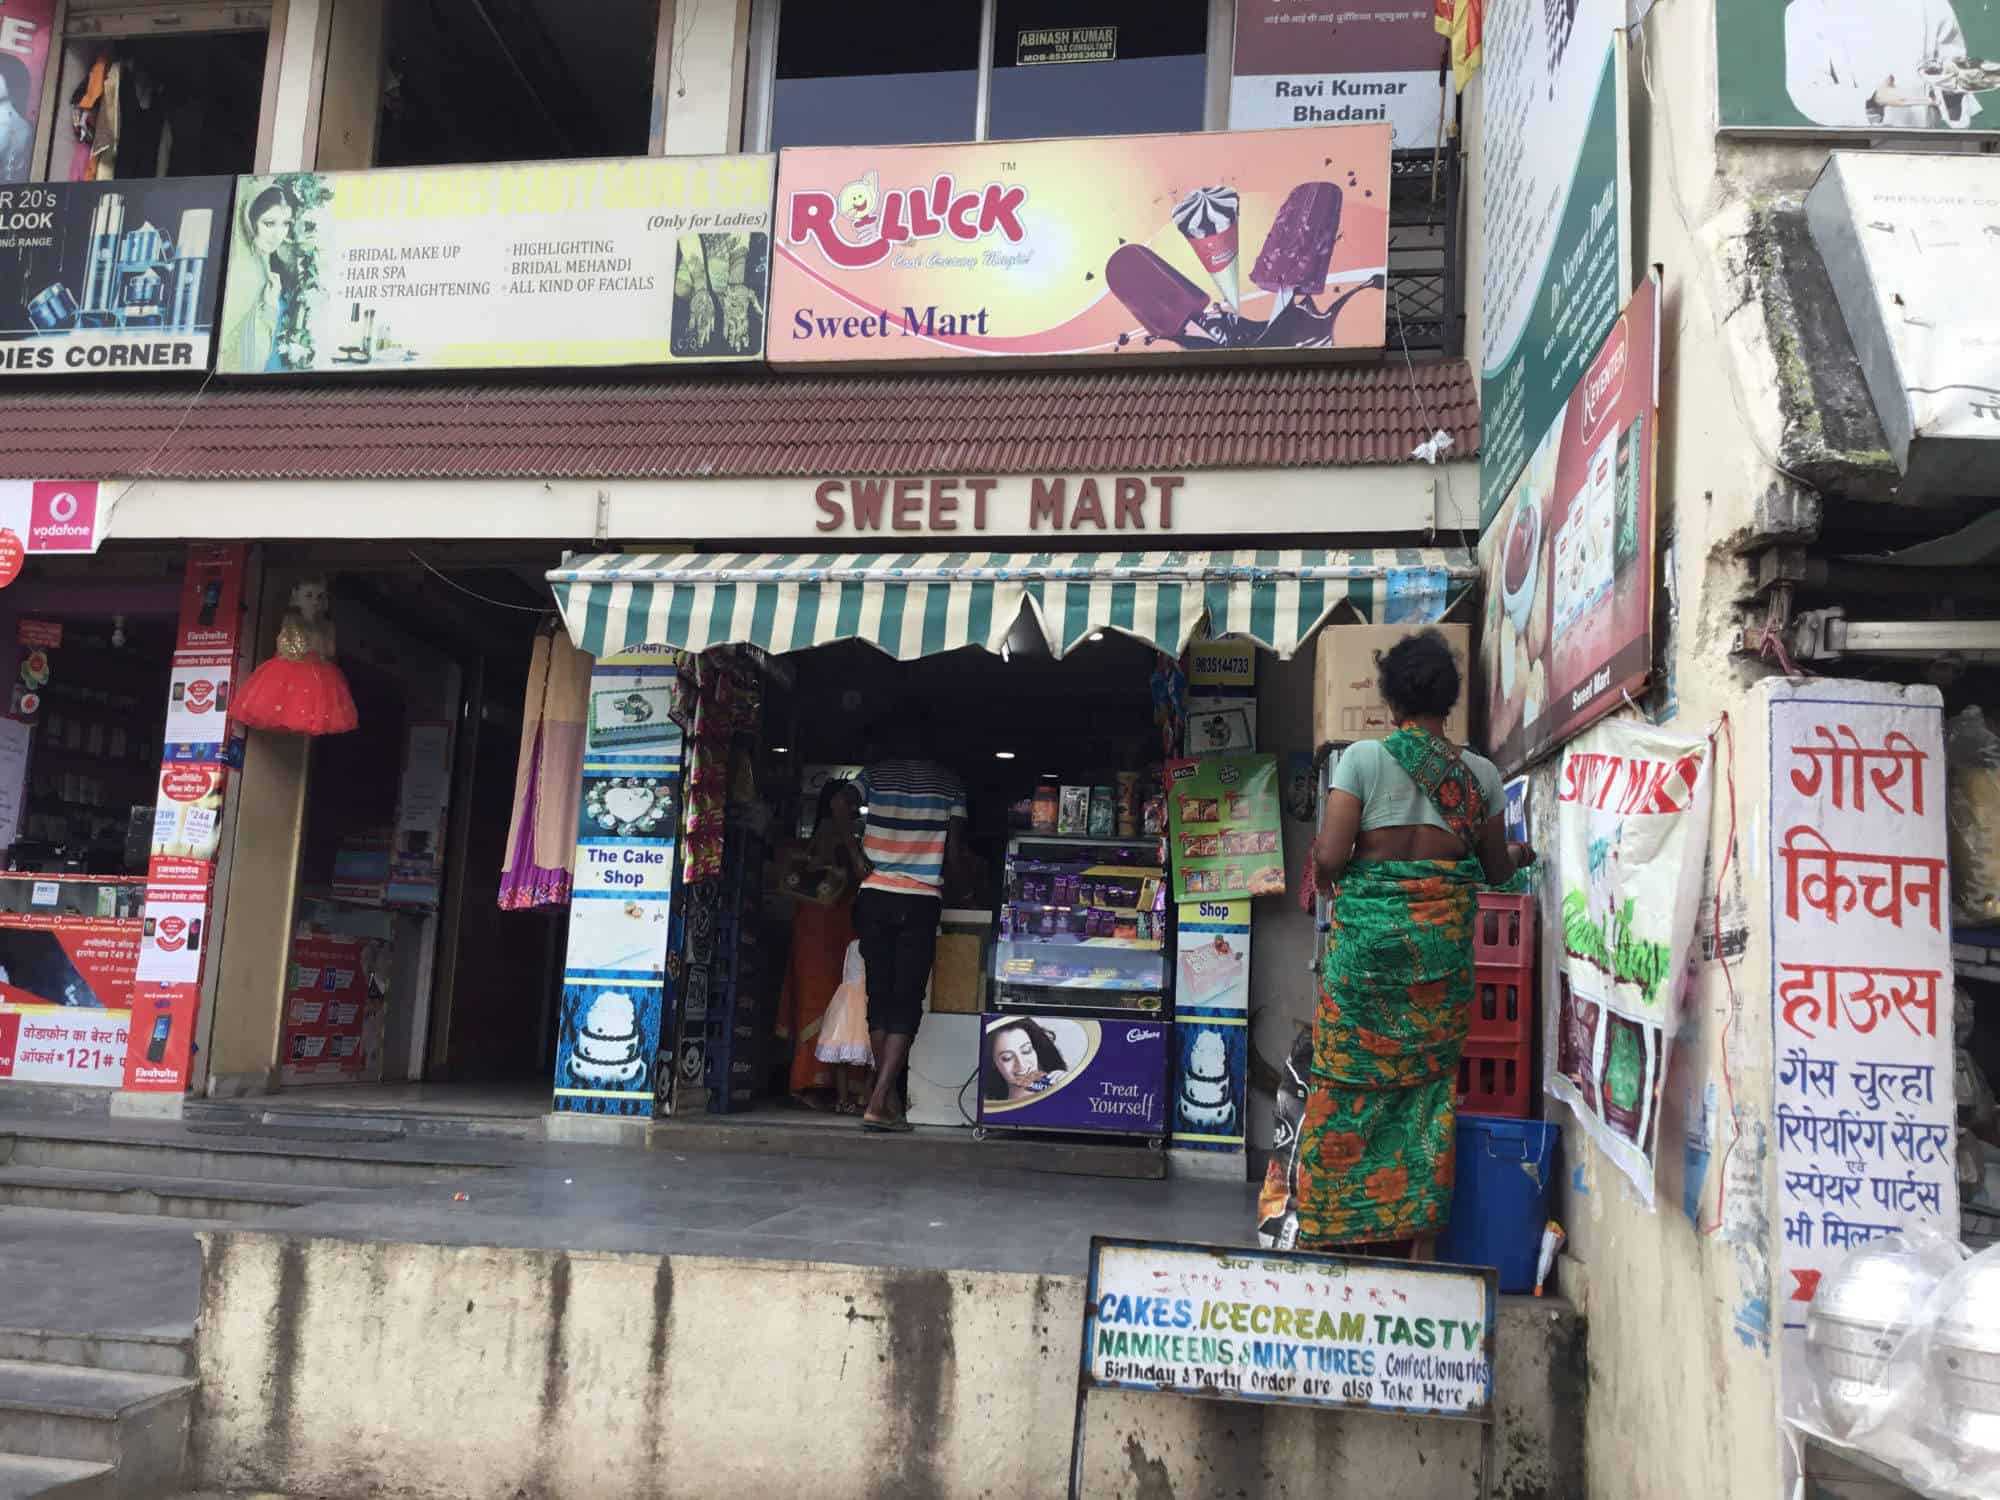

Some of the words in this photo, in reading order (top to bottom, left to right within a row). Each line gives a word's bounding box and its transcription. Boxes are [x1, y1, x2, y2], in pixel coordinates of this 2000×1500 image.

[1021, 31, 1069, 46] ABINASH
[1073, 29, 1113, 42] KUMAR
[1275, 81, 1323, 98] Ravi
[1332, 80, 1407, 97] Kumar
[1293, 104, 1387, 122] Bhadani
[19, 190, 57, 208] 20's
[0, 212, 54, 230] LOOK
[647, 215, 686, 231] (Only
[689, 214, 712, 229] for
[714, 212, 768, 227] Ladies)
[18, 237, 53, 248] RANGE
[513, 240, 614, 256] HIGHLIGHTING
[348, 248, 397, 262] BRIDAL
[400, 247, 439, 260] MAKE
[442, 245, 461, 259] UP
[346, 267, 379, 281] HAIR
[382, 266, 406, 280] SPA
[511, 261, 562, 275] BRIDAL
[565, 258, 632, 273] MEHANDI
[345, 285, 378, 299] HAIR
[380, 282, 491, 298] STRAIGHTENING
[509, 280, 535, 294] ALL
[538, 279, 573, 292] KIND
[576, 278, 595, 292] OF
[598, 276, 655, 291] FACIALS
[792, 307, 891, 341] Sweet
[902, 306, 989, 337] Mart
[65, 342, 193, 368] CORNER
[815, 478, 998, 531] SWEET
[1029, 476, 1185, 530] MART
[33, 524, 91, 536] vodafone
[1790, 724, 1929, 816] गौरी
[588, 848, 618, 863] The
[623, 849, 664, 864] Cake
[603, 870, 645, 886] Shop
[1778, 825, 1947, 932] किचन
[1199, 903, 1229, 920] Shop
[1779, 963, 1943, 1039] हाऊस
[72, 1029, 87, 1043] का
[1780, 1048, 1840, 1099] गैस
[1849, 1061, 1936, 1111] चुल्हा
[1100, 1082, 1139, 1097] Treat
[1088, 1093, 1154, 1121] Yourself
[1776, 1103, 1888, 1160] रिपेयरिंग
[1891, 1112, 1950, 1166] सेंटर
[1785, 1163, 1863, 1209] स्पेयर
[1784, 1211, 1814, 1248] भी
[1373, 1314, 1482, 1351] TASTY
[1097, 1329, 1234, 1366] NAMKEENS
[1386, 1351, 1489, 1385] Confectionaries
[1104, 1360, 1176, 1386] Birthday
[1194, 1367, 1242, 1391] Party
[1251, 1371, 1297, 1392] Order
[1303, 1377, 1331, 1395] are
[1342, 1379, 1373, 1399] also
[1381, 1379, 1415, 1404] Take
[1423, 1383, 1463, 1405] Here
